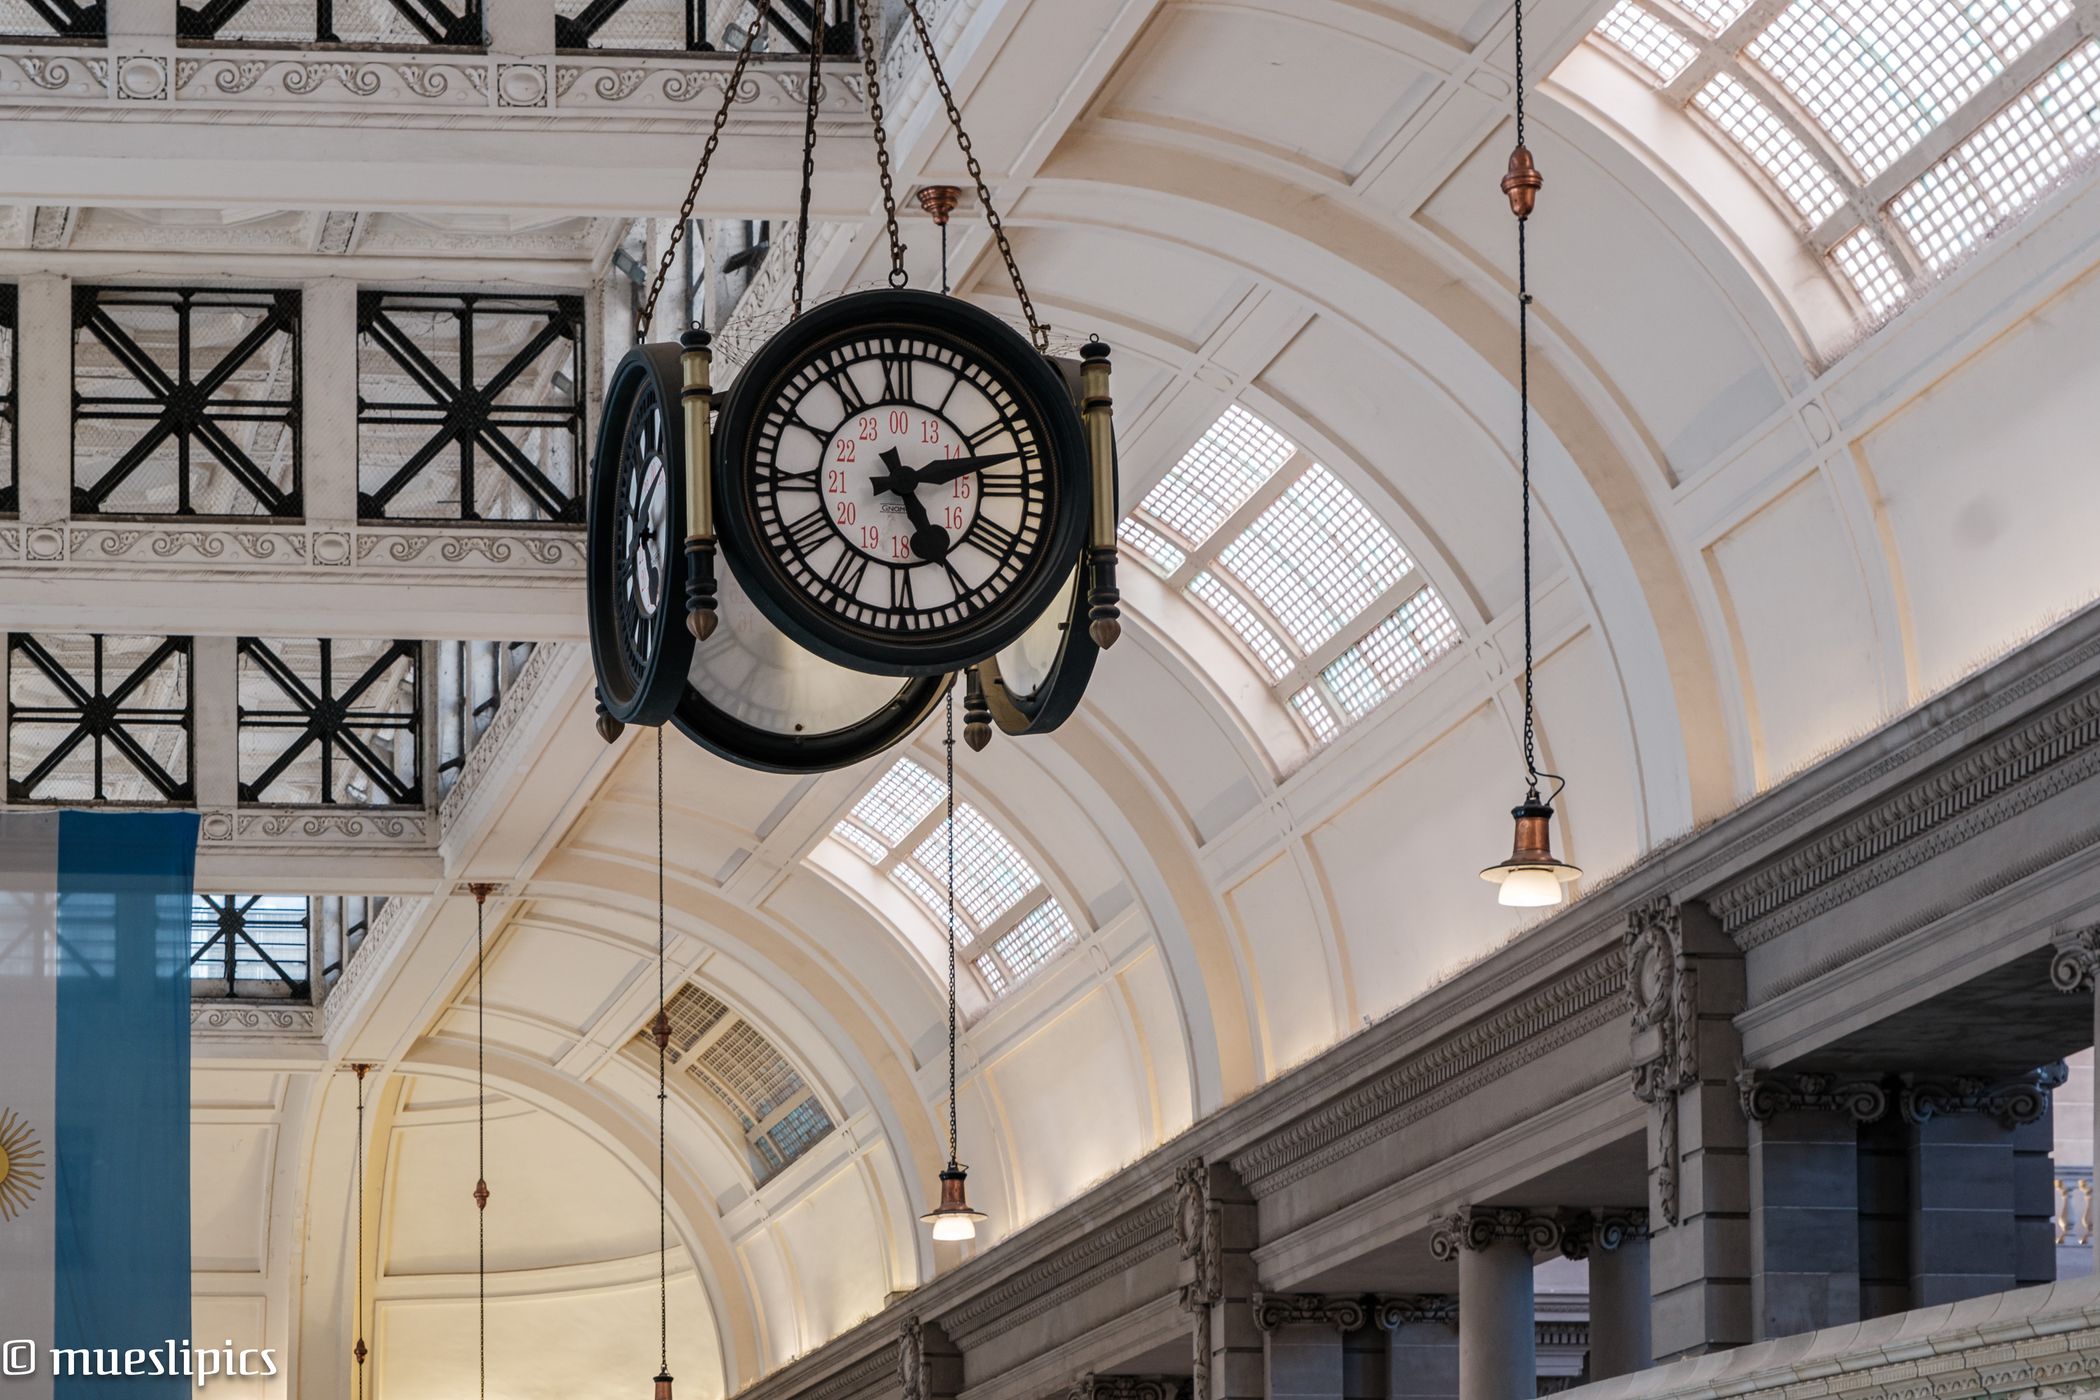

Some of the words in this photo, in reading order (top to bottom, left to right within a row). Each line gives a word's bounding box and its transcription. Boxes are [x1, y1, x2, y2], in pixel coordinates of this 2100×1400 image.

[859, 417, 878, 441] 23
[889, 410, 909, 434] 00
[920, 420, 939, 444] 13
[837, 440, 855, 463] 22
[829, 470, 847, 494] 21
[953, 474, 970, 499] 15
[837, 502, 856, 525] 20
[945, 506, 963, 530] 16
[861, 526, 879, 549] 19
[892, 535, 910, 559] 18
